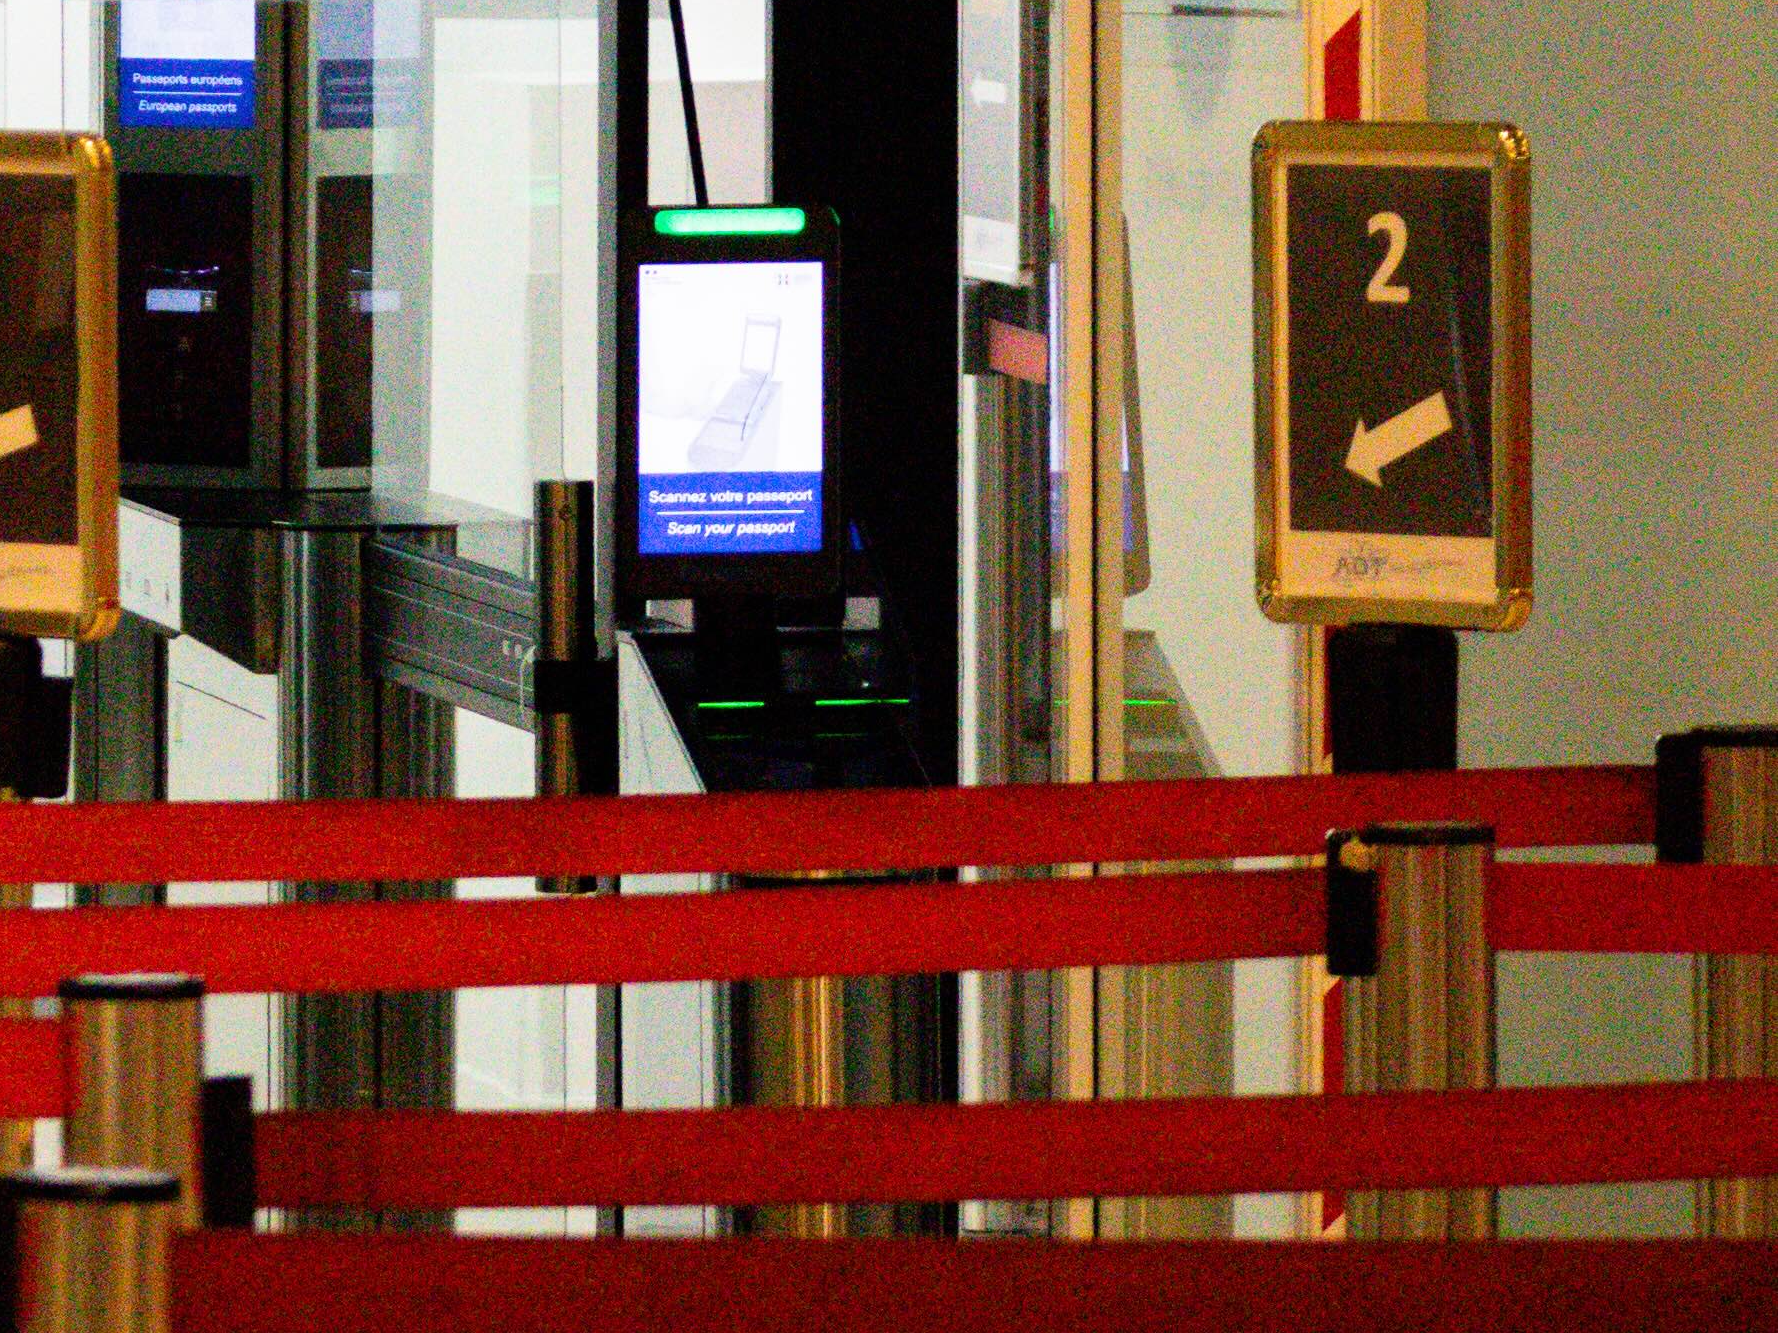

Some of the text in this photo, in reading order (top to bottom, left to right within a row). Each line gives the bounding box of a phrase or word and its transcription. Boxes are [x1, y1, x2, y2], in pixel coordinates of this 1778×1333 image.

[138, 99, 238, 116] European passports
[1366, 212, 1411, 303] 2
[648, 488, 814, 505] Scannez votre passeport
[666, 520, 797, 538] Scan your passport
